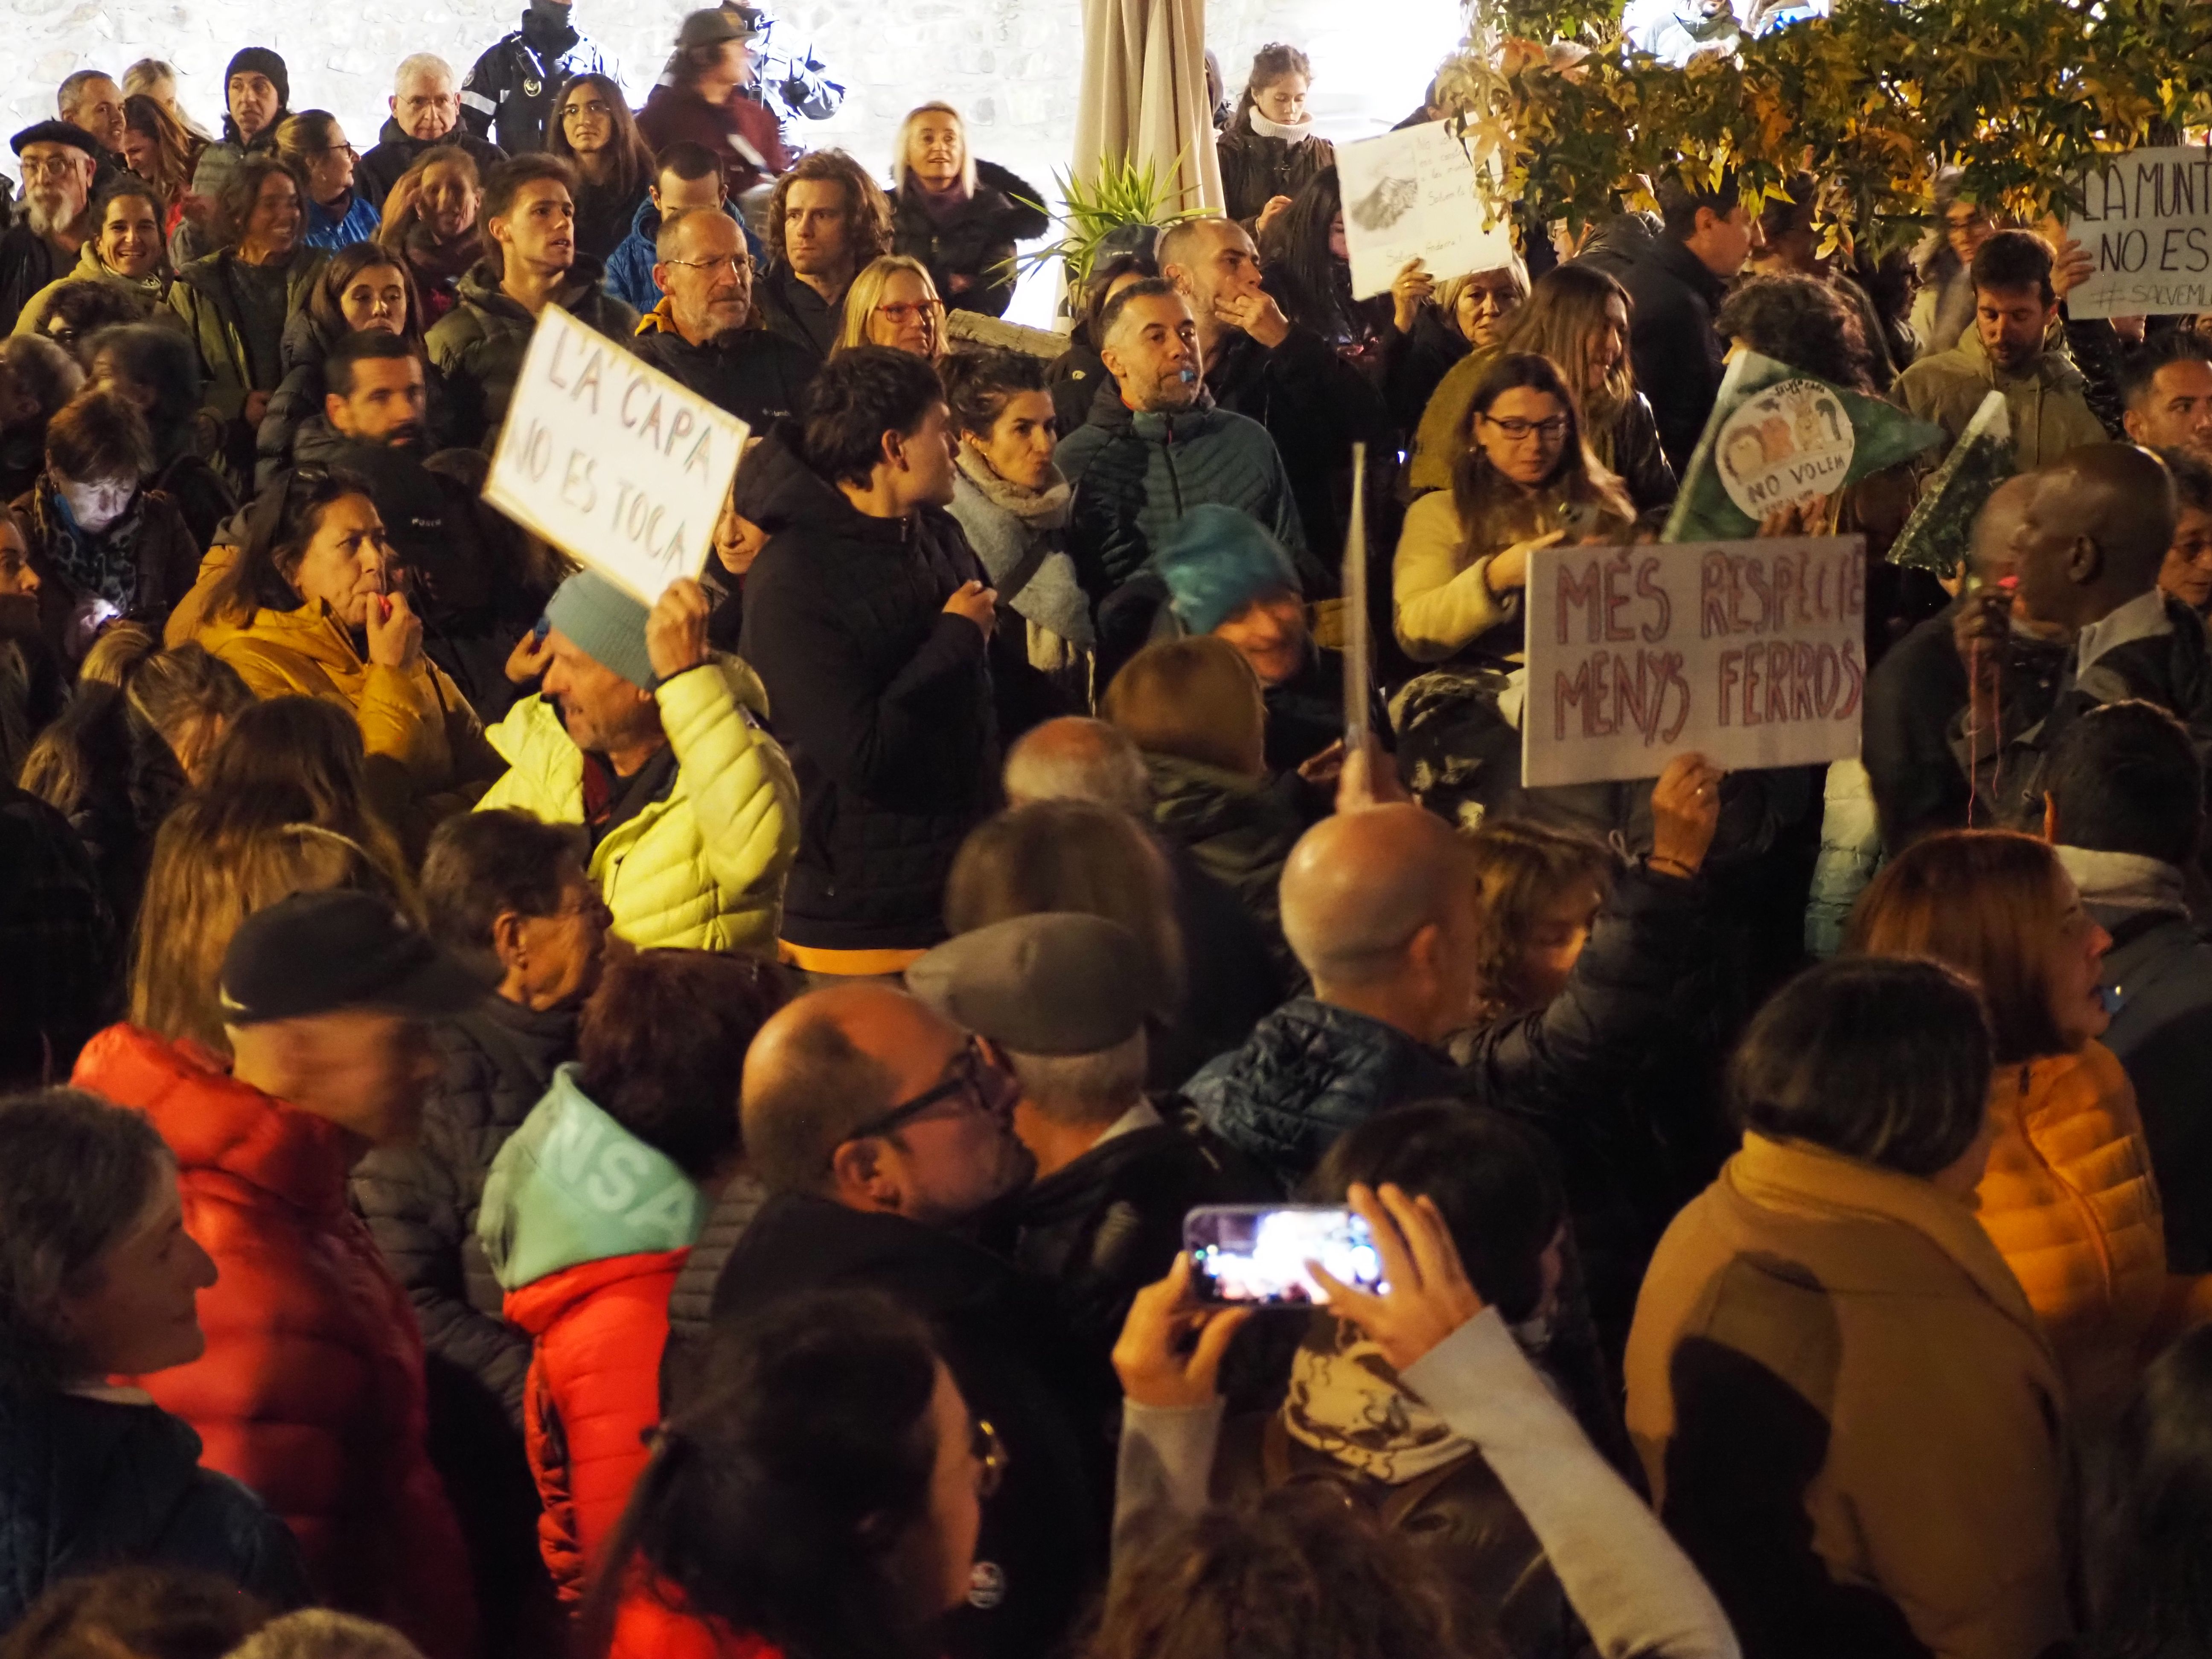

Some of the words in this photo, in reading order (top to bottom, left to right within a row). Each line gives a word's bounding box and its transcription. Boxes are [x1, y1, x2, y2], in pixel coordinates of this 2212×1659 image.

[2082, 164, 2127, 221] LA
[2135, 161, 2212, 219] MUNT
[2100, 229, 2148, 273] NO
[2160, 227, 2209, 272] ES
[548, 325, 604, 415] LA
[621, 374, 713, 488] CAPA
[508, 415, 553, 484] NO
[560, 448, 598, 514] ES
[612, 479, 685, 573] TOCA
[1747, 474, 1781, 504] NO
[1790, 453, 1846, 484] VOLEM
[1556, 544, 1671, 645] MÉS
[1718, 637, 1864, 727] FERROS
